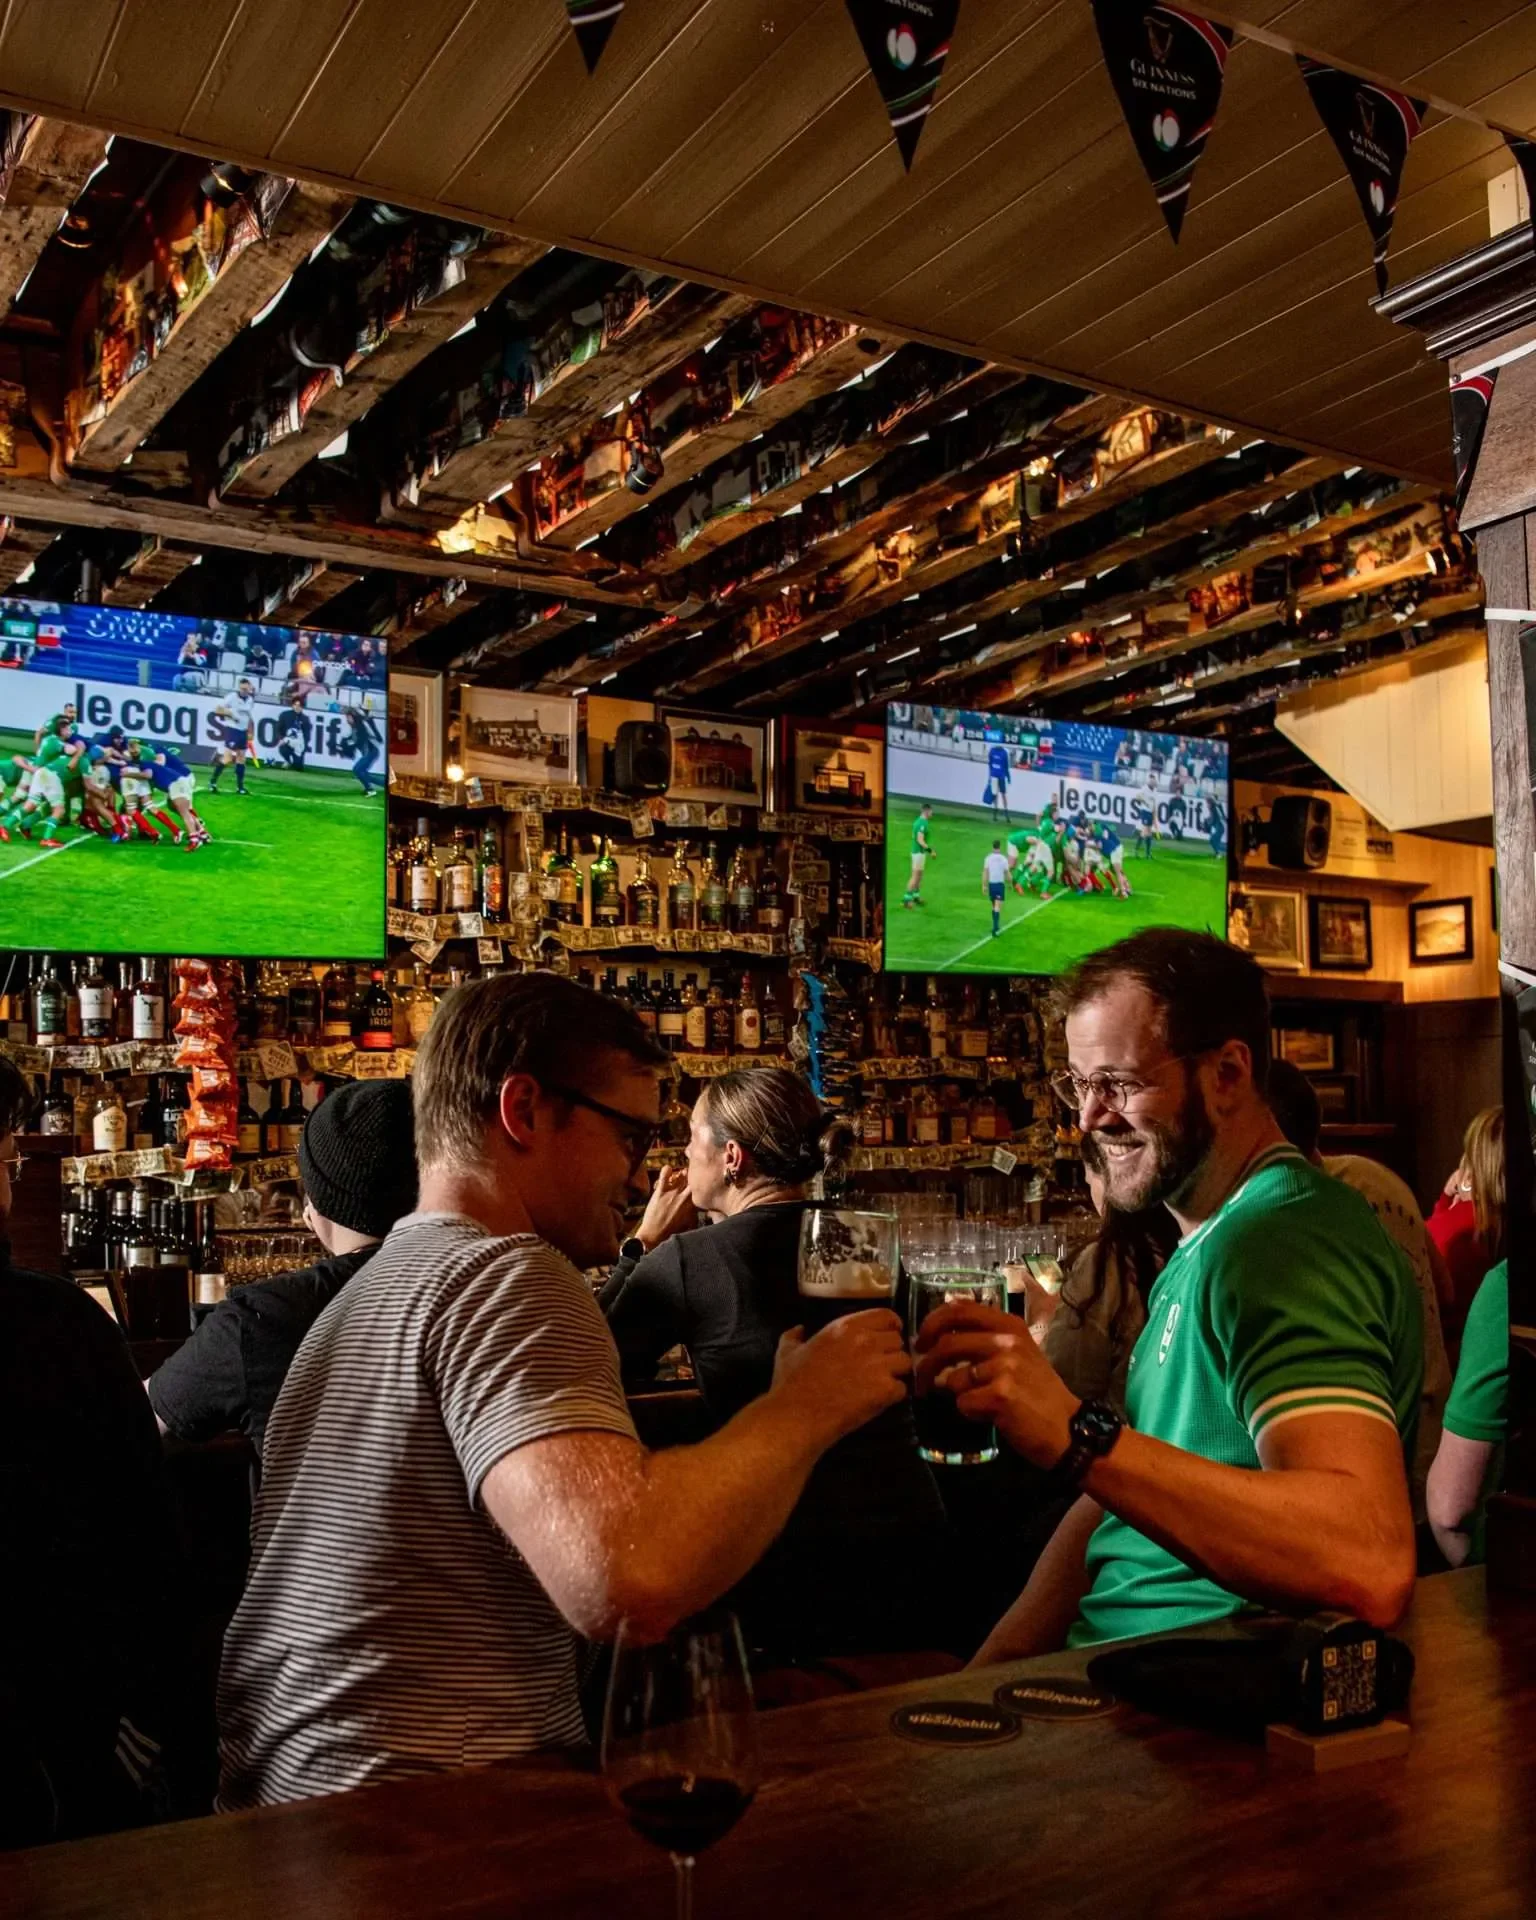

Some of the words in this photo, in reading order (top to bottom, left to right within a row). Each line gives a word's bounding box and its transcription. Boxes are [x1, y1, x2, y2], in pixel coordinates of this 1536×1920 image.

[1130, 57, 1196, 84] GUINNESS
[1132, 77, 1148, 90] SIX
[1150, 82, 1197, 100] NATIONS
[75, 683, 113, 727] le
[121, 698, 199, 745] coq
[206, 711, 342, 756] soif
[1059, 780, 1080, 811] le
[1084, 790, 1125, 822] coq
[370, 1007, 392, 1017] LOST
